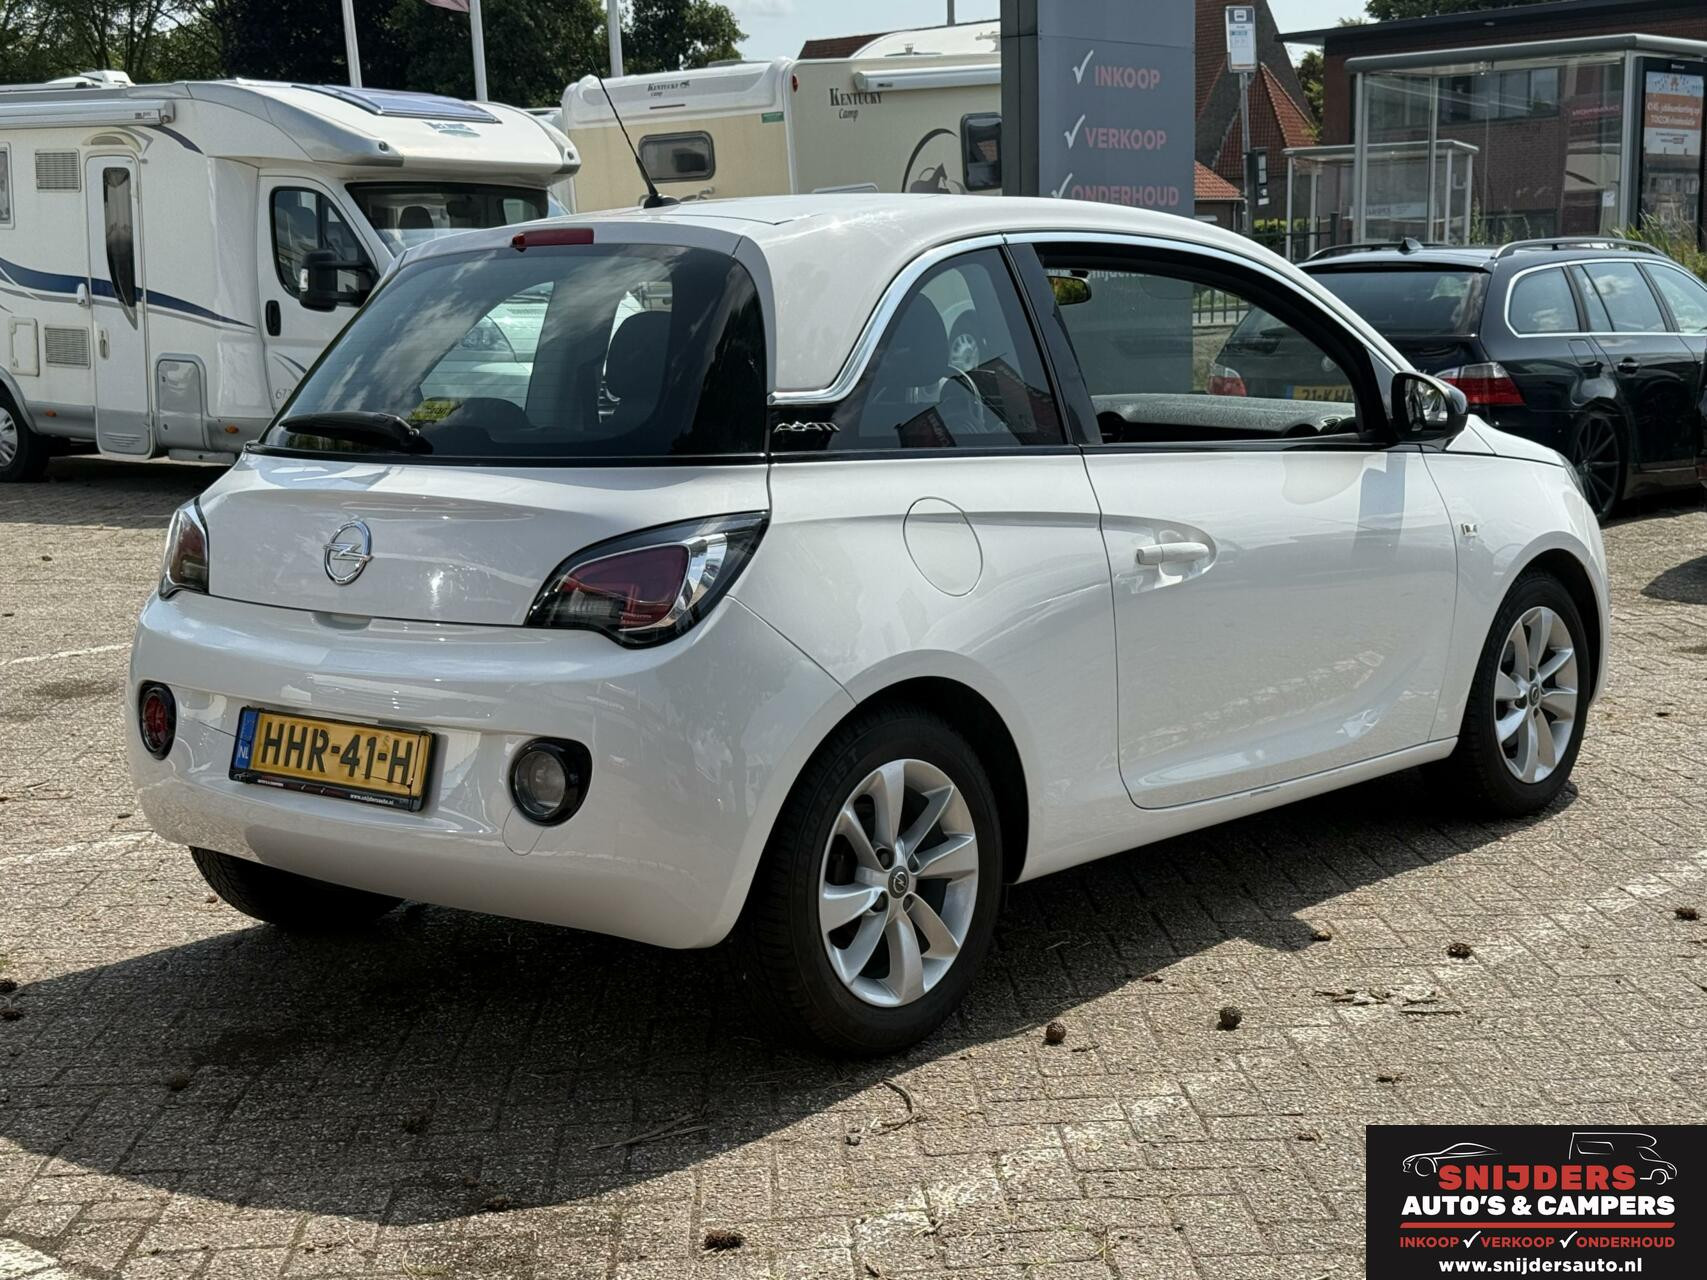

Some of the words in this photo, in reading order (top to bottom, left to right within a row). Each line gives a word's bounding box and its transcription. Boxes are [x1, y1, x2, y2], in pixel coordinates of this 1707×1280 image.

[1094, 65, 1161, 90] INKOOP
[839, 108, 859, 122] Camp
[1085, 127, 1167, 151] VERKOOP
[1072, 185, 1180, 206] ONDERHOUD
[238, 745, 249, 759] NL
[261, 721, 413, 785] HHR-41-H
